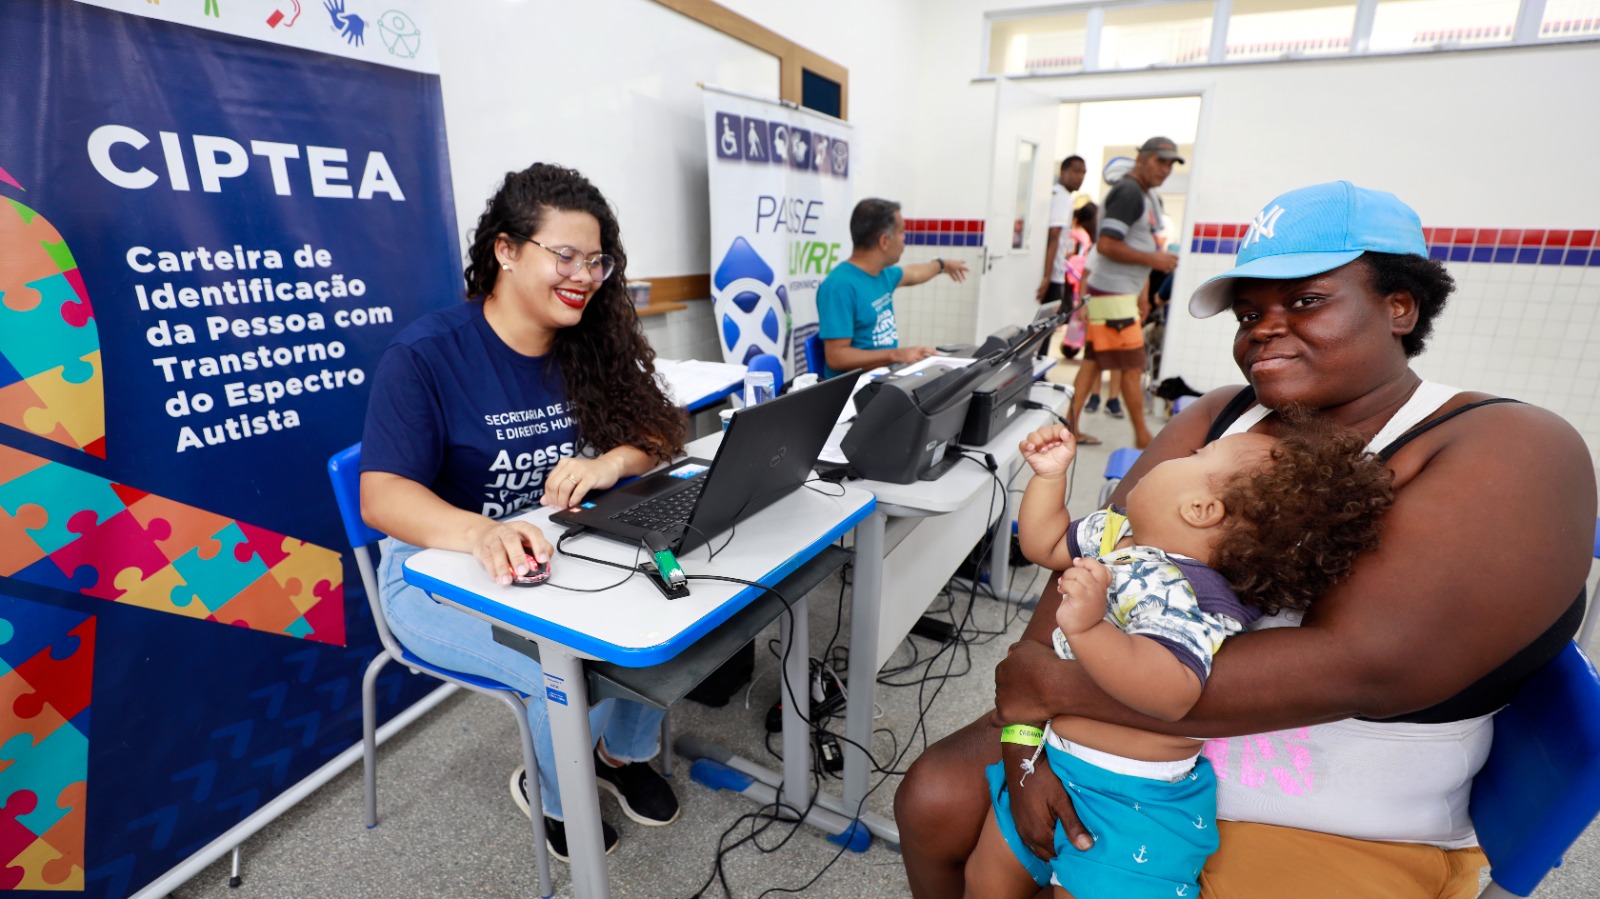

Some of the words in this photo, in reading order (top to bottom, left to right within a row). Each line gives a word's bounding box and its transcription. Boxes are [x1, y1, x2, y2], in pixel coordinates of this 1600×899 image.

[87, 124, 406, 202] CIPTEA
[756, 195, 824, 234] PASSE
[126, 244, 283, 273] Carteira
[293, 243, 332, 268] de
[134, 273, 366, 311] Identificação
[146, 319, 196, 347] da
[206, 312, 325, 341] Pessoa
[334, 306, 393, 328] com
[152, 341, 346, 383] Transtorno
[165, 390, 214, 418] do
[224, 368, 365, 407] Espectro
[176, 408, 301, 453] Autista
[484, 408, 546, 426] SECRETARIA
[546, 403, 564, 417] DE
[496, 429, 505, 440] E
[506, 422, 549, 440] DIREITOS
[484, 466, 554, 490] JUS
